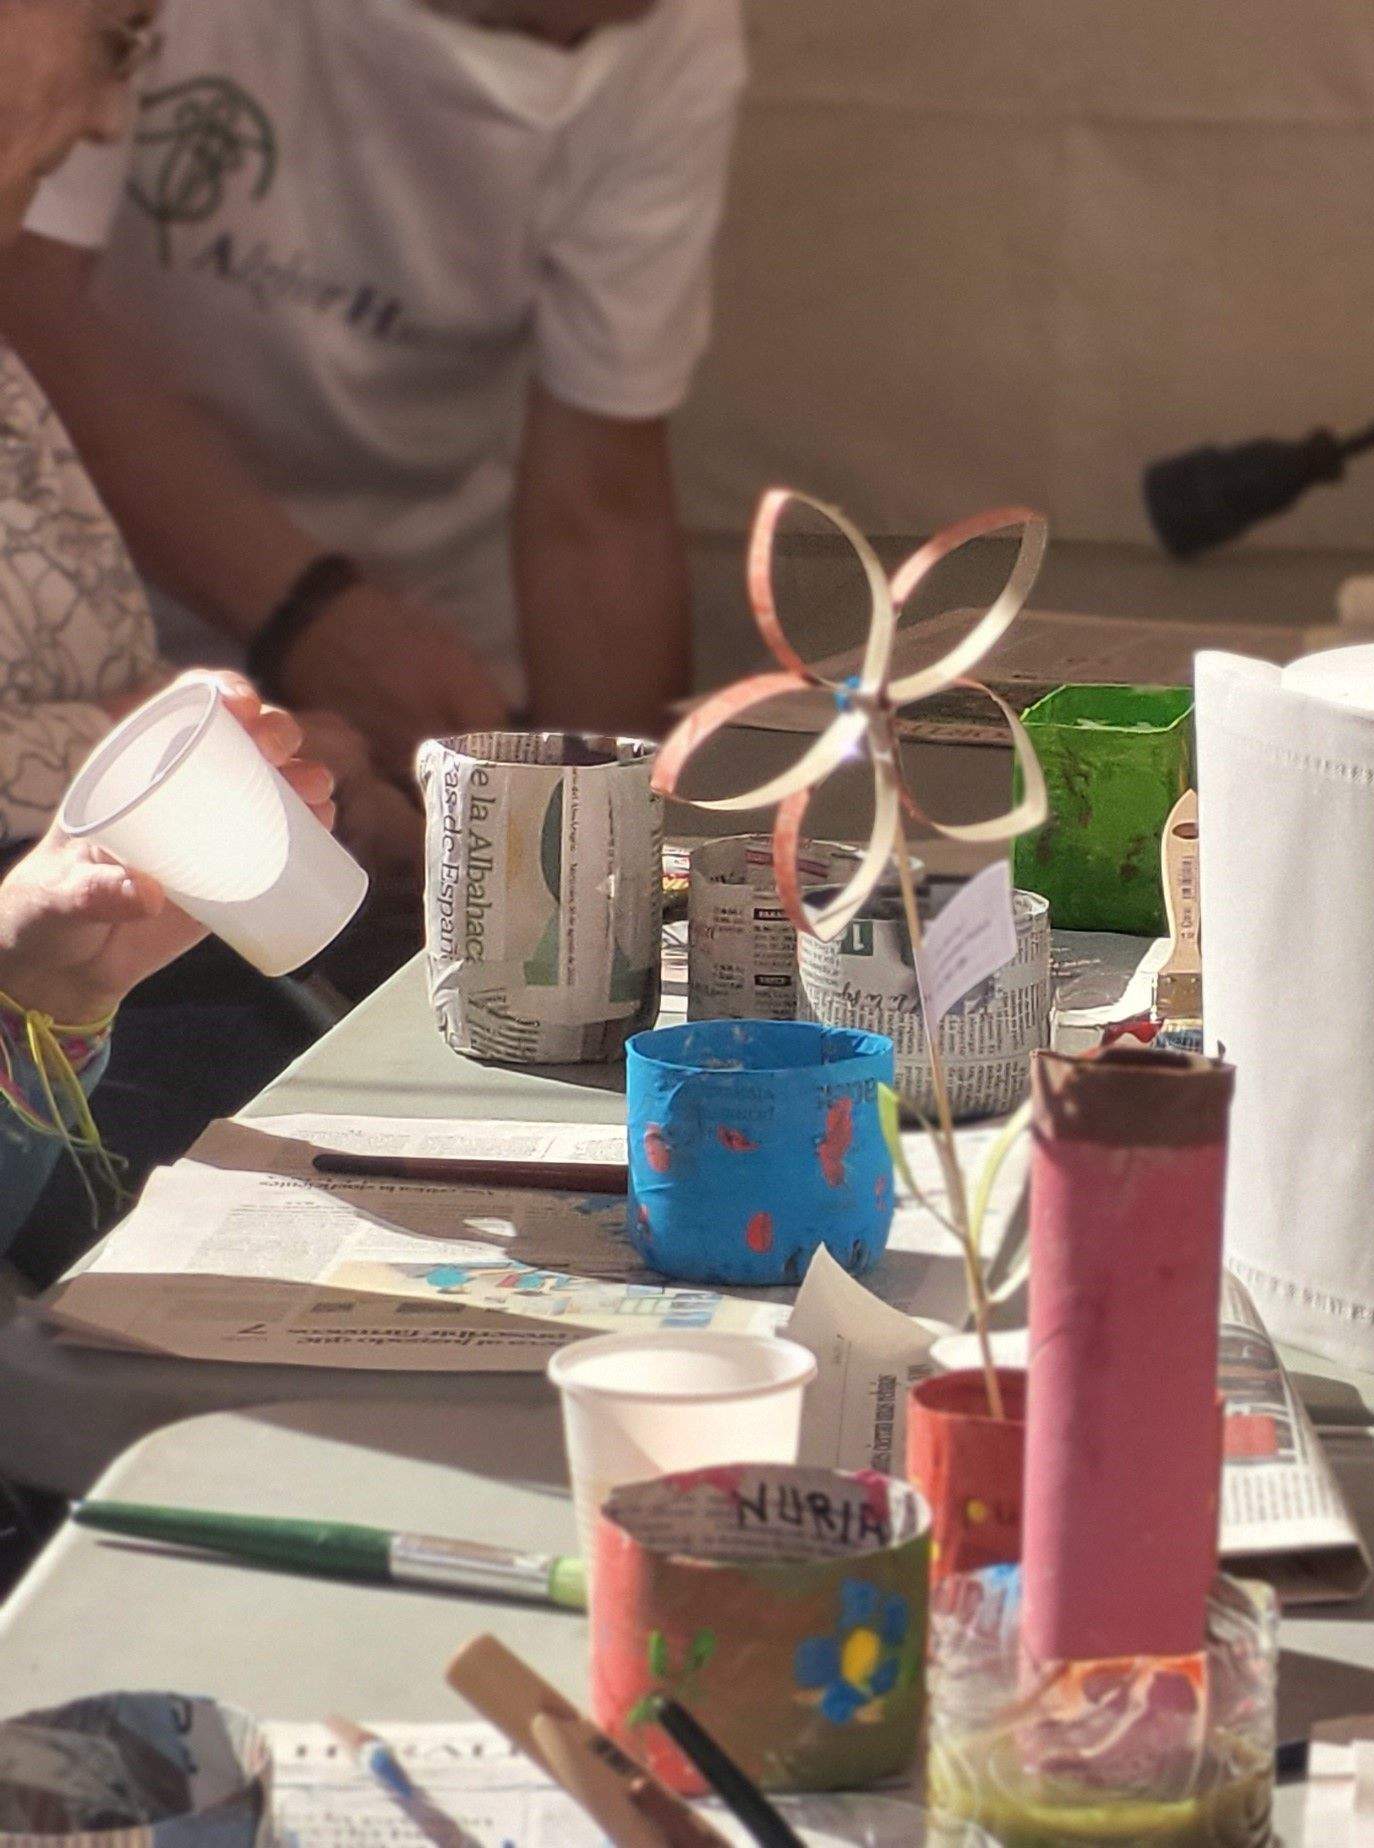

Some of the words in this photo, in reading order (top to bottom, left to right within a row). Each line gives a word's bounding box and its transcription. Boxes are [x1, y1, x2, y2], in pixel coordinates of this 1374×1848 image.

[471, 764, 494, 787] e
[470, 795, 496, 822] la
[731, 1481, 890, 1545] NURIA
